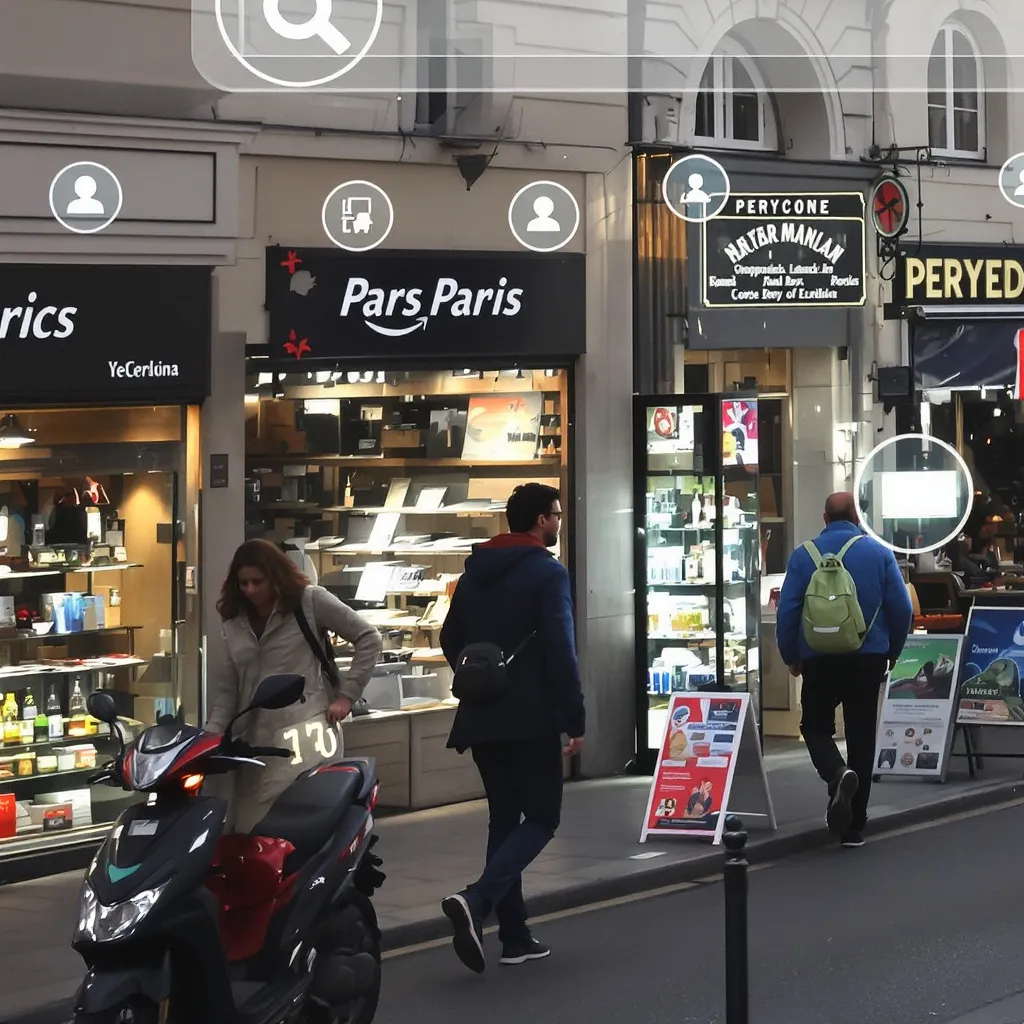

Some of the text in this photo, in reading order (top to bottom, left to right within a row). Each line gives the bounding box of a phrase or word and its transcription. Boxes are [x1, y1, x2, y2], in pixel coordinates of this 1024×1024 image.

[735, 199, 830, 215] PERYCONE
[0, 291, 78, 340] rics
[339, 276, 524, 318] Pars Paris
